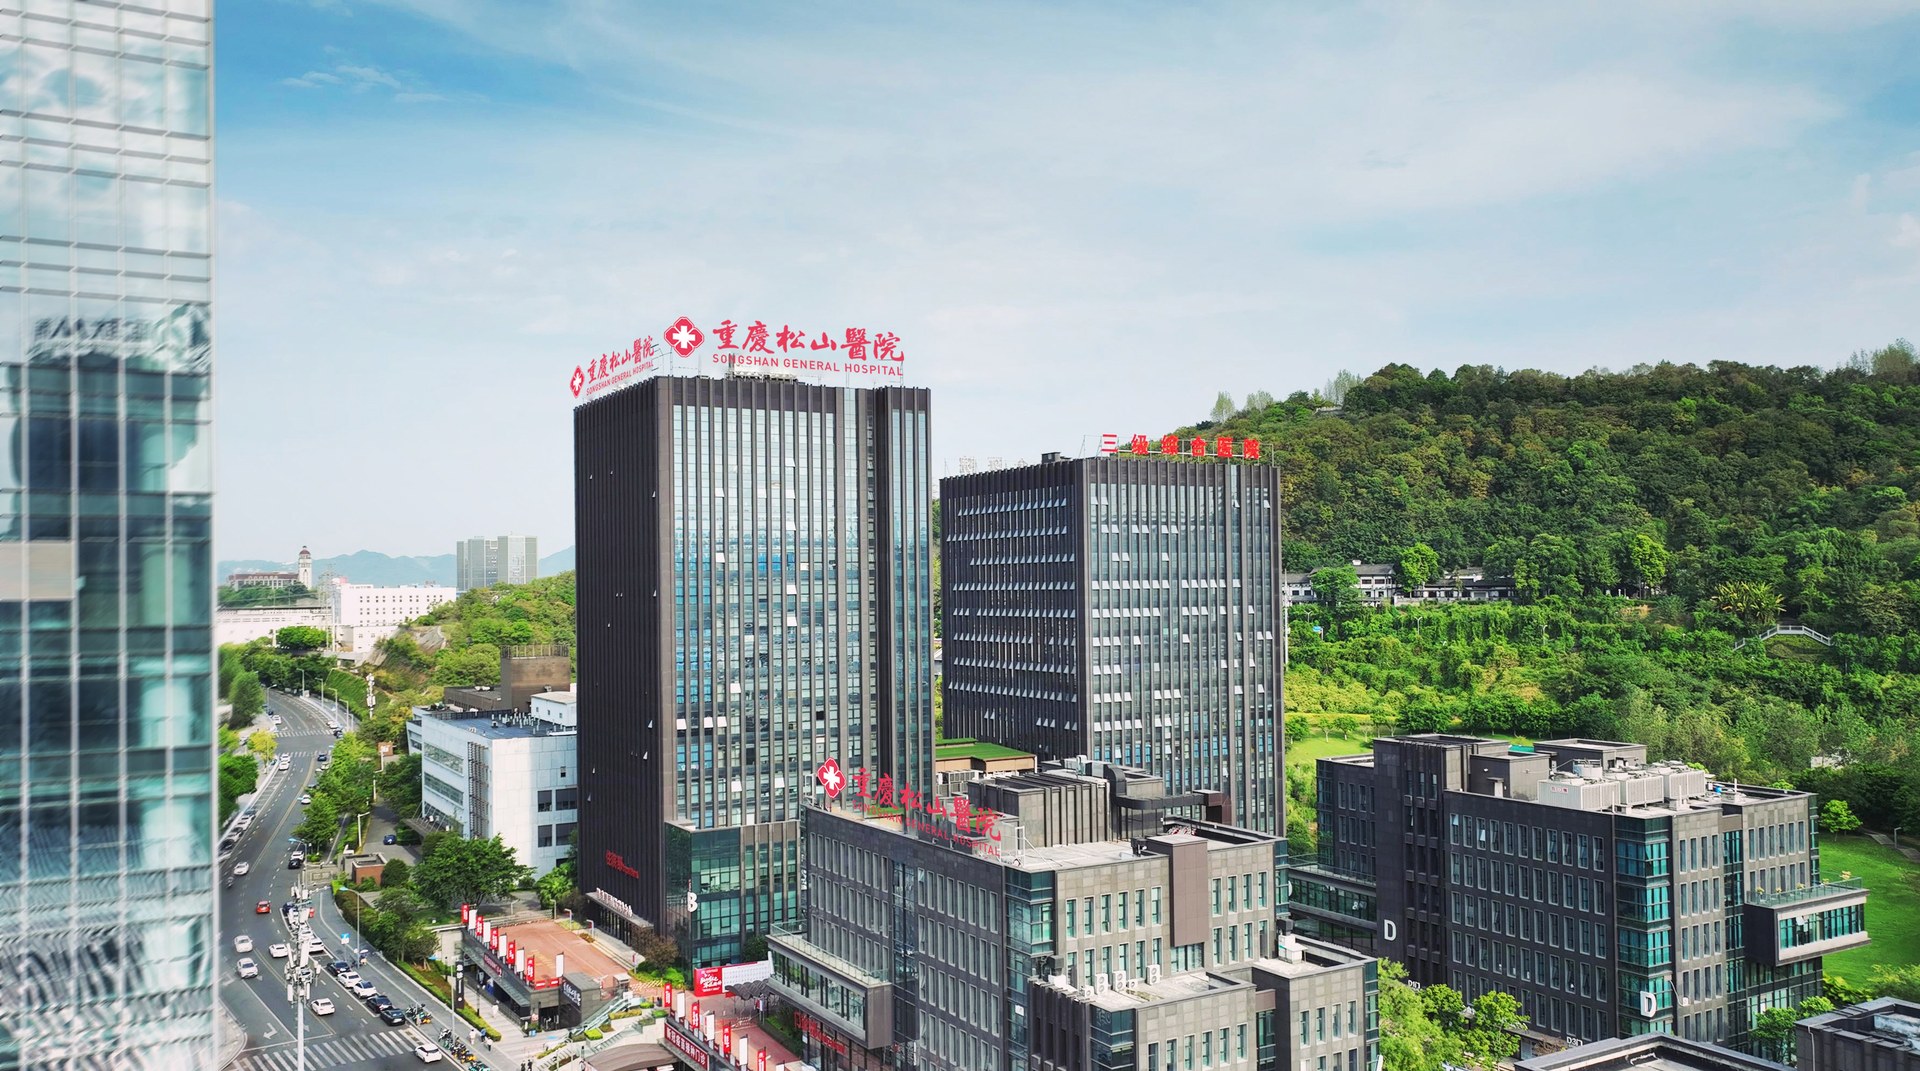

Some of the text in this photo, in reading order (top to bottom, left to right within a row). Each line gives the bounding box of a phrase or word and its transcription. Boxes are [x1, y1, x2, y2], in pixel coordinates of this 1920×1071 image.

[712, 319, 906, 362] 重慶松山醫院
[587, 335, 655, 384] 重慶松山醫院
[712, 353, 904, 377] SONGSHAN GENERAL HOSPITAL
[586, 360, 654, 396] SONGSHAN GENERAL HOSPITAL
[852, 767, 1004, 842] 重慶松山醫院
[852, 800, 1001, 857] SONGSHAN GENERAL HOSPITAL
[687, 891, 698, 913] B
[1384, 919, 1397, 941] D
[1639, 990, 1657, 1018] D
